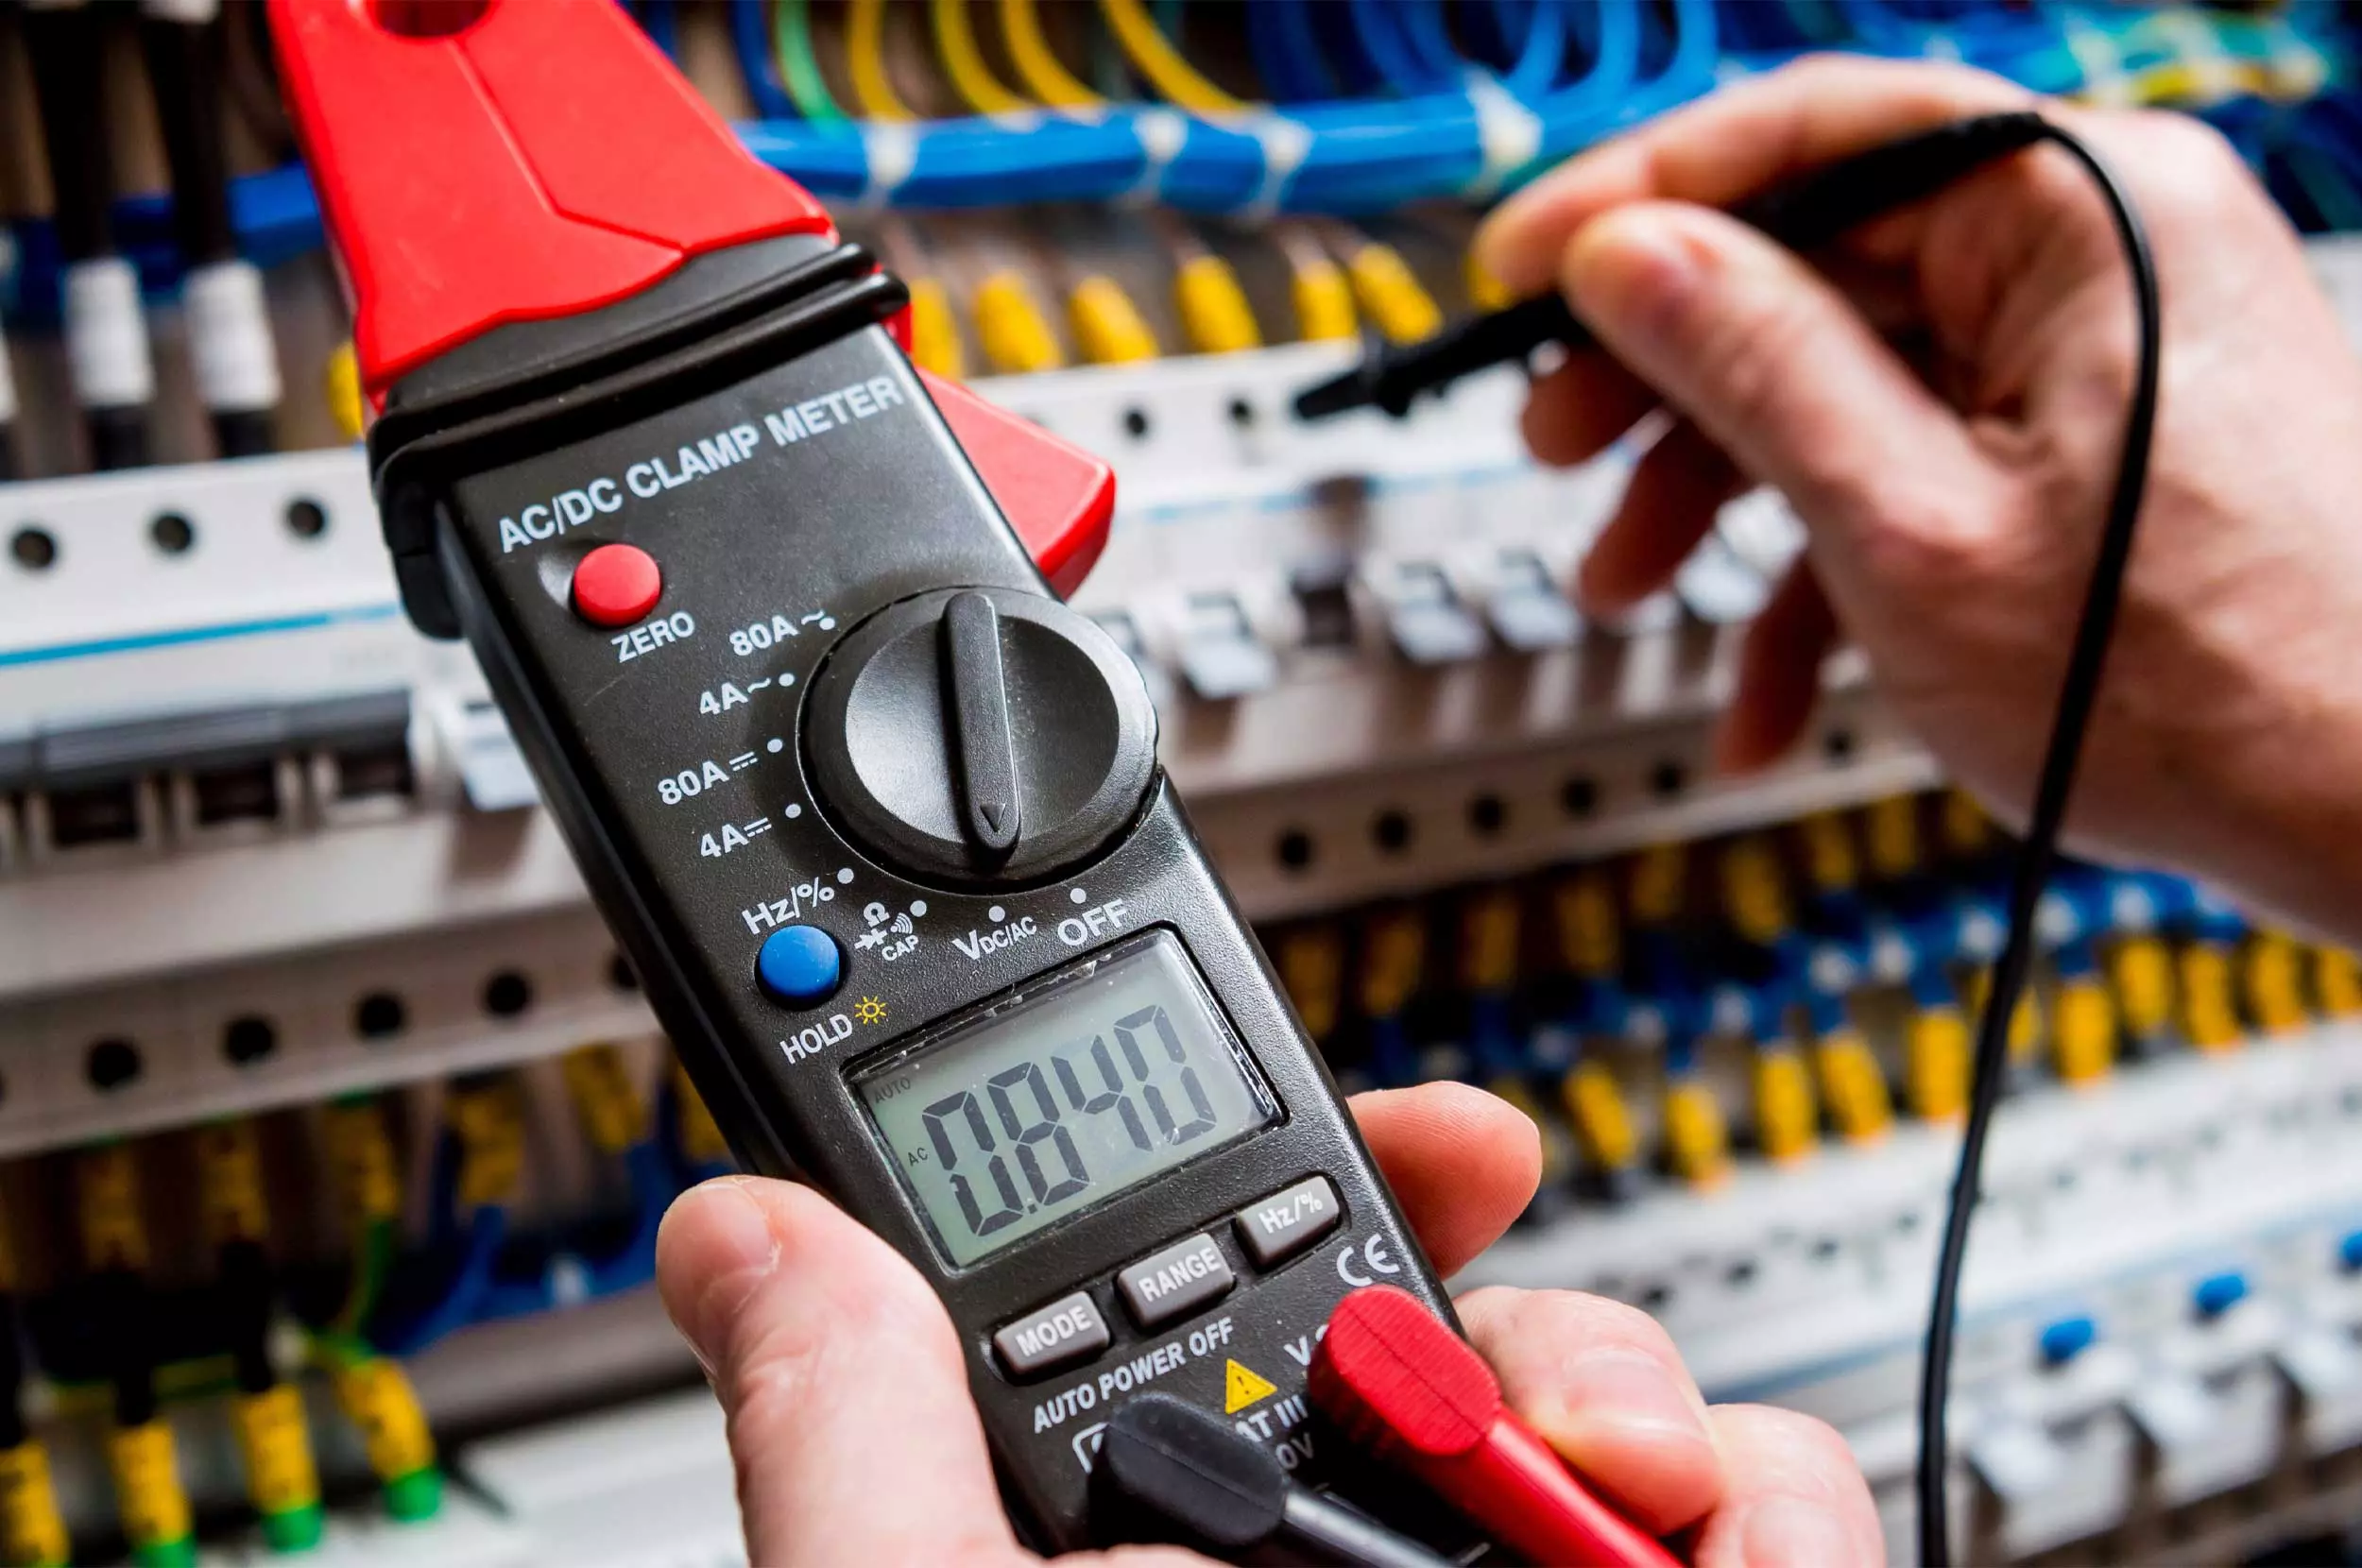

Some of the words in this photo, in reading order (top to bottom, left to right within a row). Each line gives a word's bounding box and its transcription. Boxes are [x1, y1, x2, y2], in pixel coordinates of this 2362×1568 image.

[500, 479, 623, 553] AC/DC
[625, 425, 760, 499] CLAMP
[763, 376, 903, 446] METER
[611, 610, 695, 662] ZERO
[741, 877, 834, 935] Hz/%
[1057, 898, 1129, 946] OFF
[881, 934, 919, 962] CAP
[779, 1014, 853, 1064] HOLD
[874, 1077, 911, 1104] AUTO
[908, 1147, 928, 1167] AC
[1258, 1191, 1324, 1235] Hz/%
[1138, 1247, 1222, 1303] RANGE
[1016, 1305, 1093, 1357] MODE
[1033, 1387, 1096, 1434] AUTO
[1100, 1340, 1187, 1401] POWER
[1189, 1317, 1235, 1357] OFF
[1235, 1410, 1273, 1442] AT
